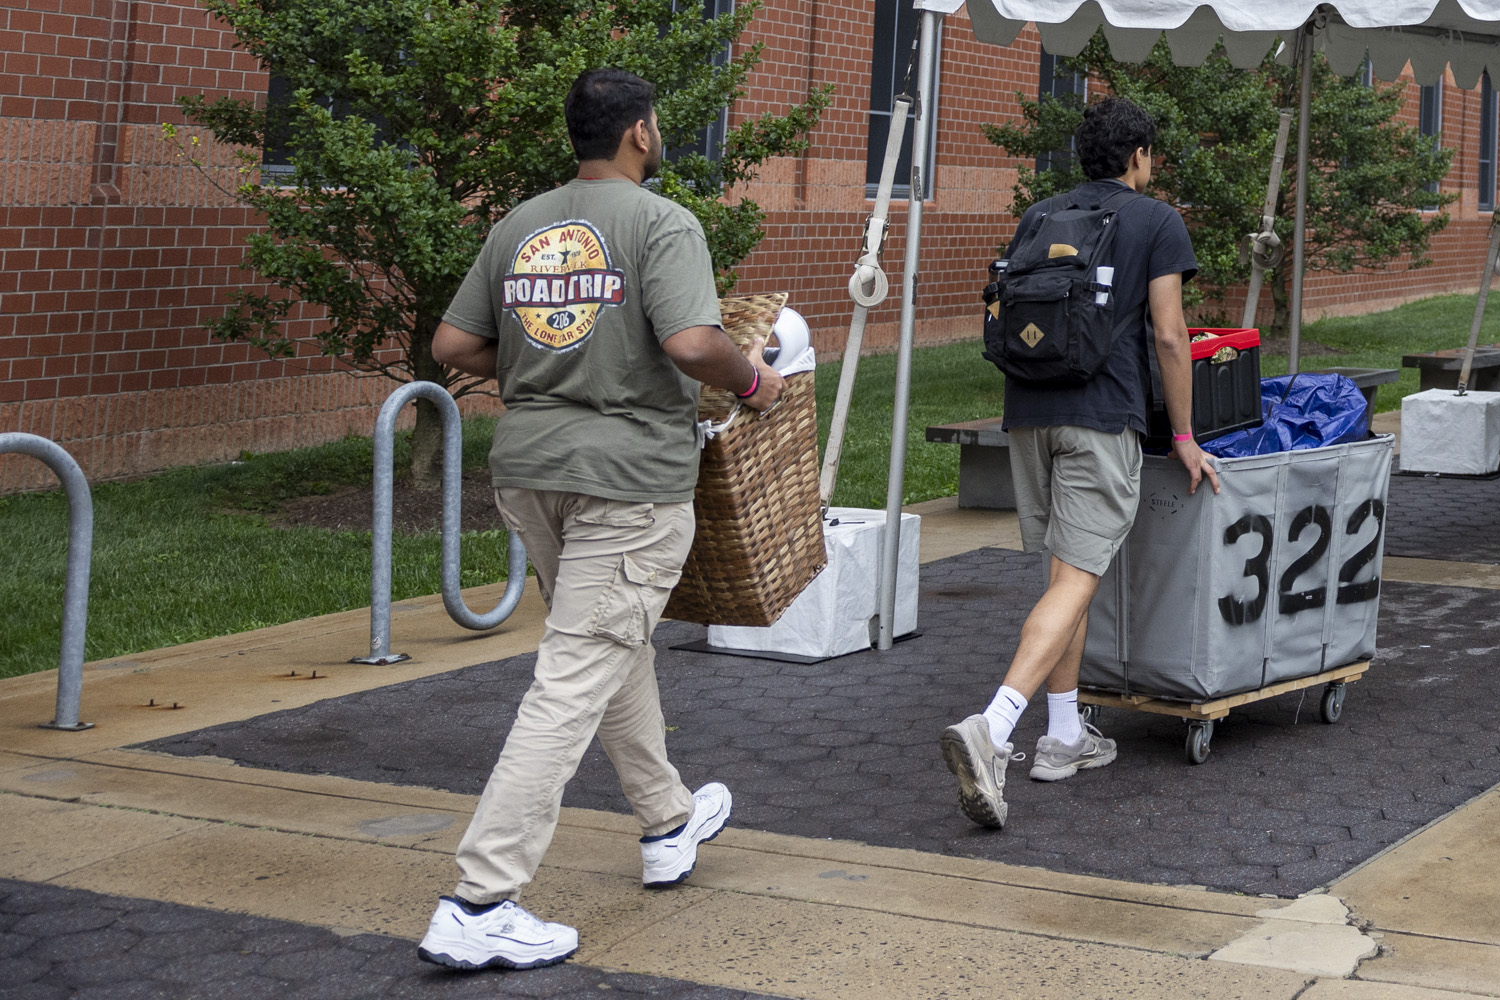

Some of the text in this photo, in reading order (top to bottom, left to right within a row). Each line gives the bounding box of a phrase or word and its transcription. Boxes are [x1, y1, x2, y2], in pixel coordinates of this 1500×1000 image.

[521, 229, 600, 263] SAN ANTONIO
[504, 273, 621, 304] ROAD TRIP
[521, 313, 534, 330] THE
[1151, 499, 1176, 508] STEELE
[1218, 498, 1385, 626] 322
